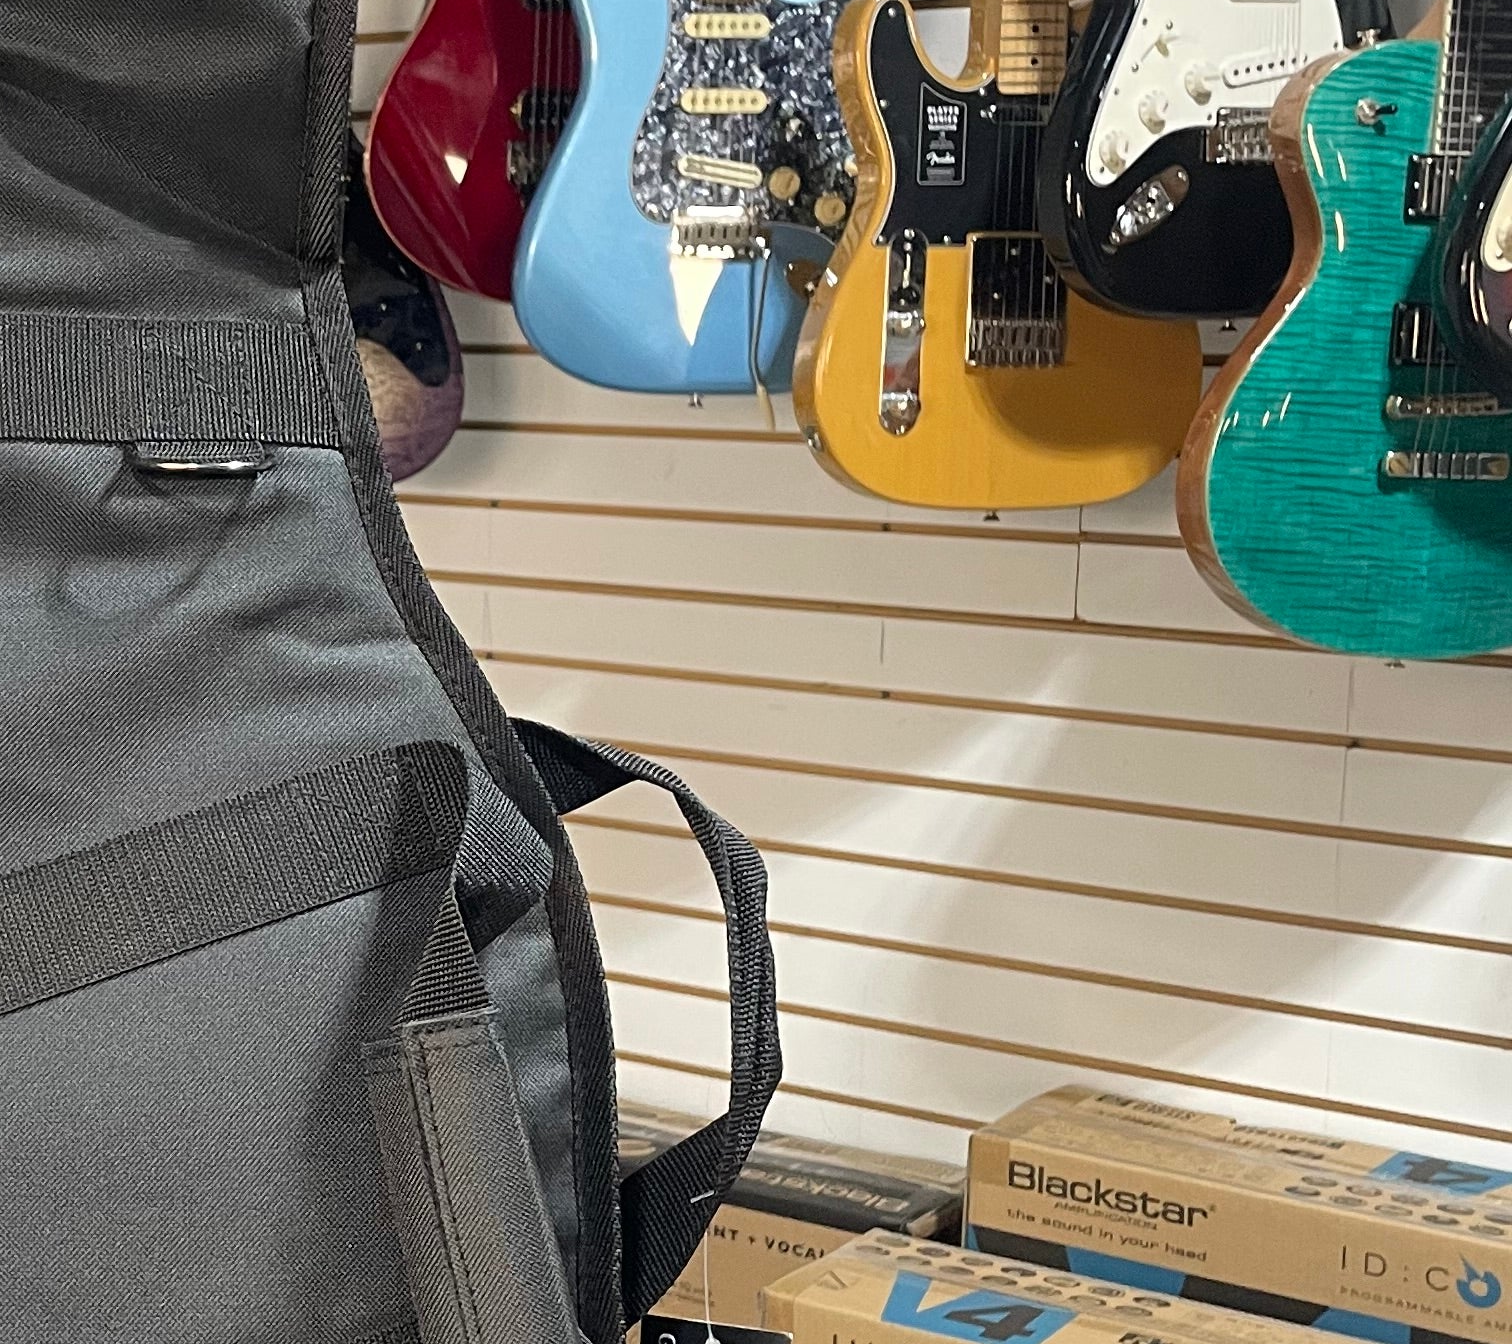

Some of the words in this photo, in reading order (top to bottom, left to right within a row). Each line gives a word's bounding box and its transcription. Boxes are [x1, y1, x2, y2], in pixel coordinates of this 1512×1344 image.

[926, 105, 960, 117] PLAYER
[928, 114, 959, 125] SERIES
[1008, 1160, 1209, 1228] Blackstar
[1006, 1207, 1036, 1223] the
[1041, 1216, 1093, 1237] sound
[1099, 1227, 1114, 1242] in
[1119, 1234, 1160, 1249] your
[1164, 1242, 1208, 1263] head
